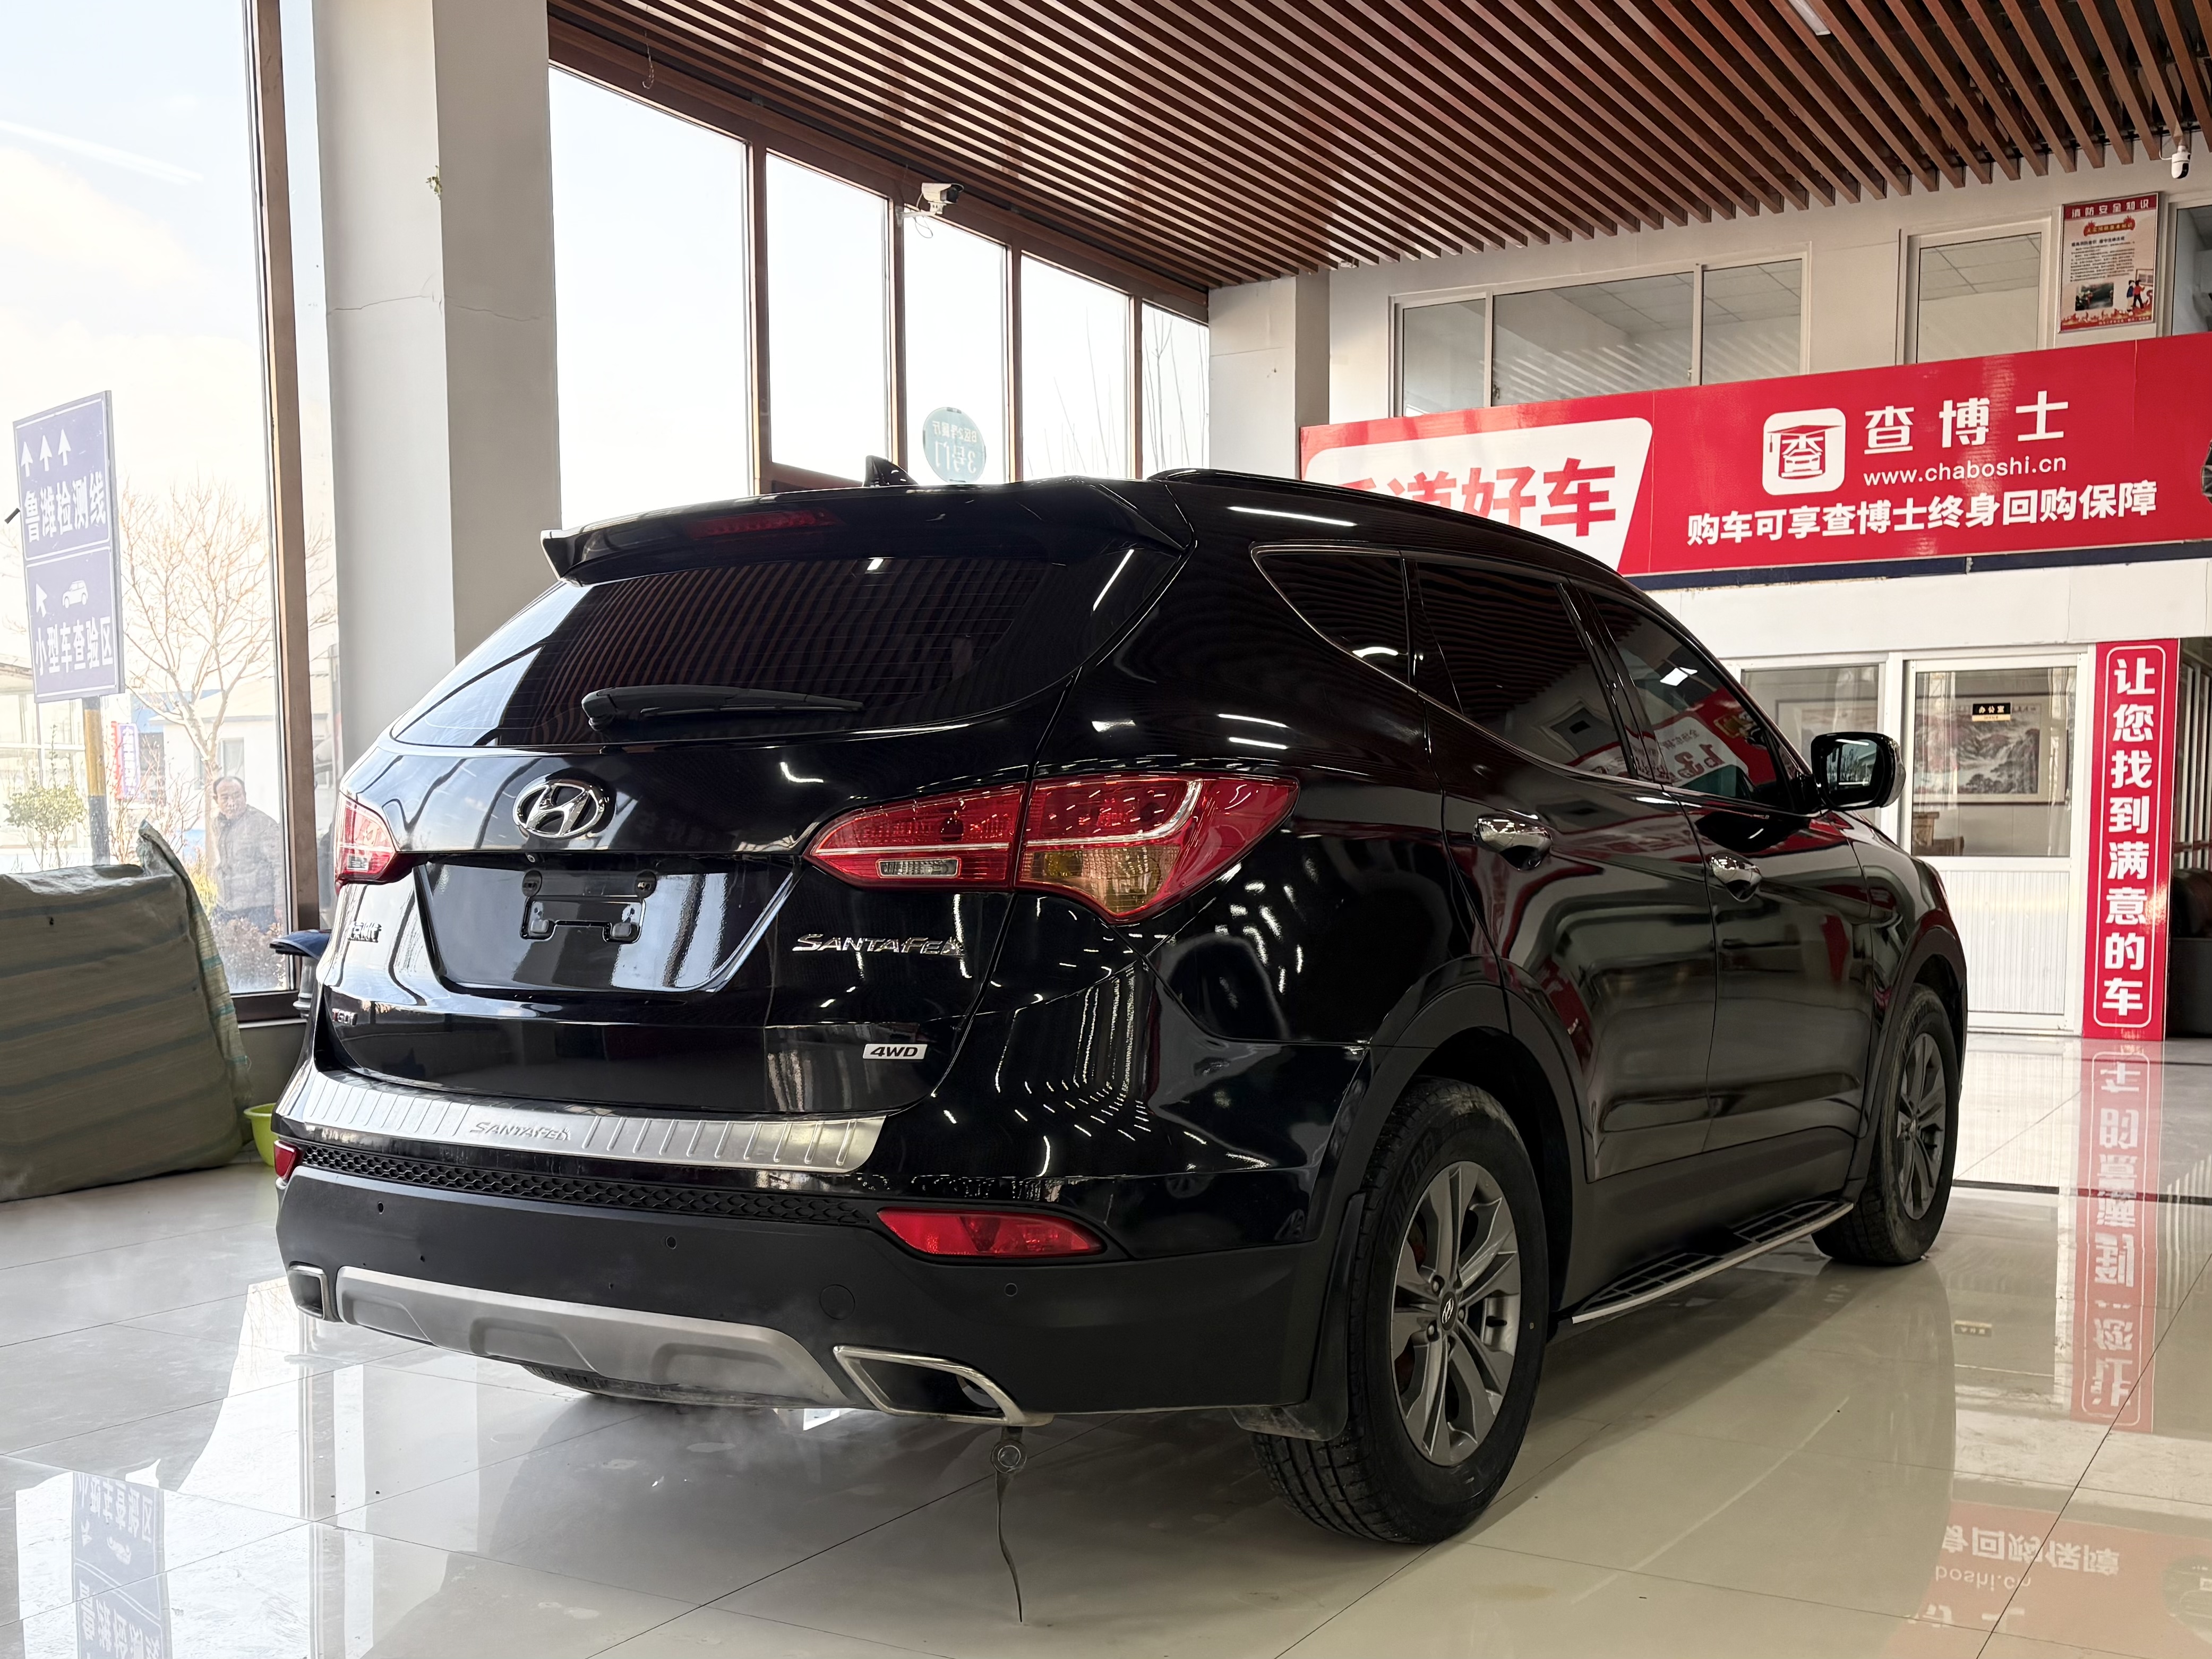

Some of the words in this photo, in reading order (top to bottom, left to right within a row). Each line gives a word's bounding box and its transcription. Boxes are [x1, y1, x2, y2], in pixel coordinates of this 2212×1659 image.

[2072, 199, 2149, 218] 消防安全知识
[1864, 390, 2069, 455] 查博士
[1338, 457, 1616, 537] 道好车
[1864, 455, 2067, 486] www.chaboshi.cn
[24, 471, 107, 543] 鲁潍检测线
[1687, 478, 2157, 546] 购车可享查博士终身回购保障
[35, 615, 113, 677] 小型车查验区
[2102, 657, 2156, 1016] 让您找到满意的车
[870, 1046, 919, 1057] 4WD
